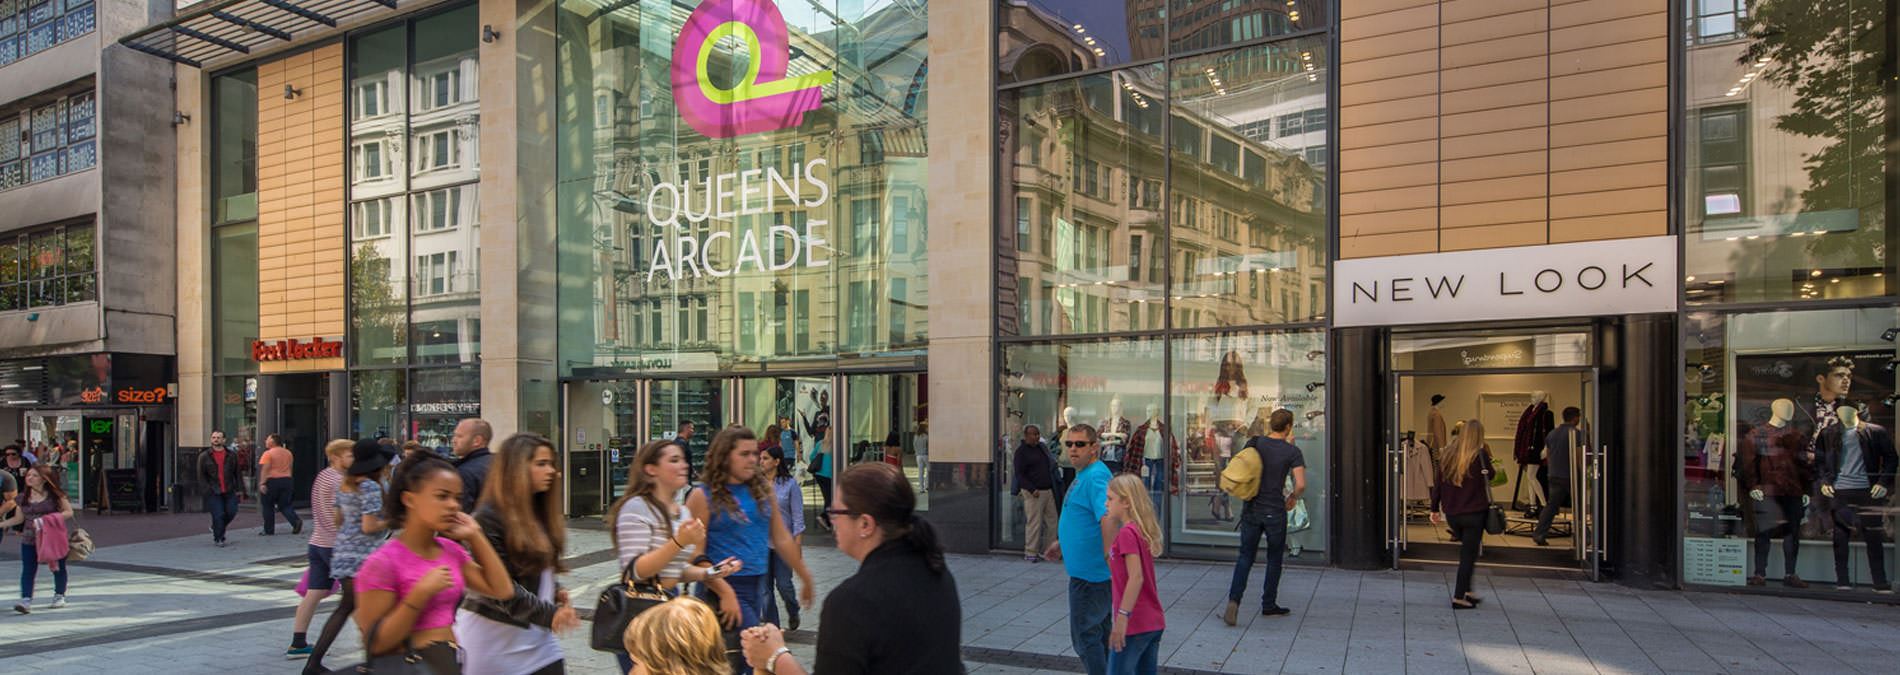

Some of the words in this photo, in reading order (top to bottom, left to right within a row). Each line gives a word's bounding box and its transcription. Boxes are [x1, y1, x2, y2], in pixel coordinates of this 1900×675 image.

[647, 158, 829, 232] QUEENS
[647, 219, 830, 282] ARCADE
[1352, 274, 1465, 304] NEW
[1499, 262, 1654, 296] LOOK
[117, 386, 166, 403] size?
